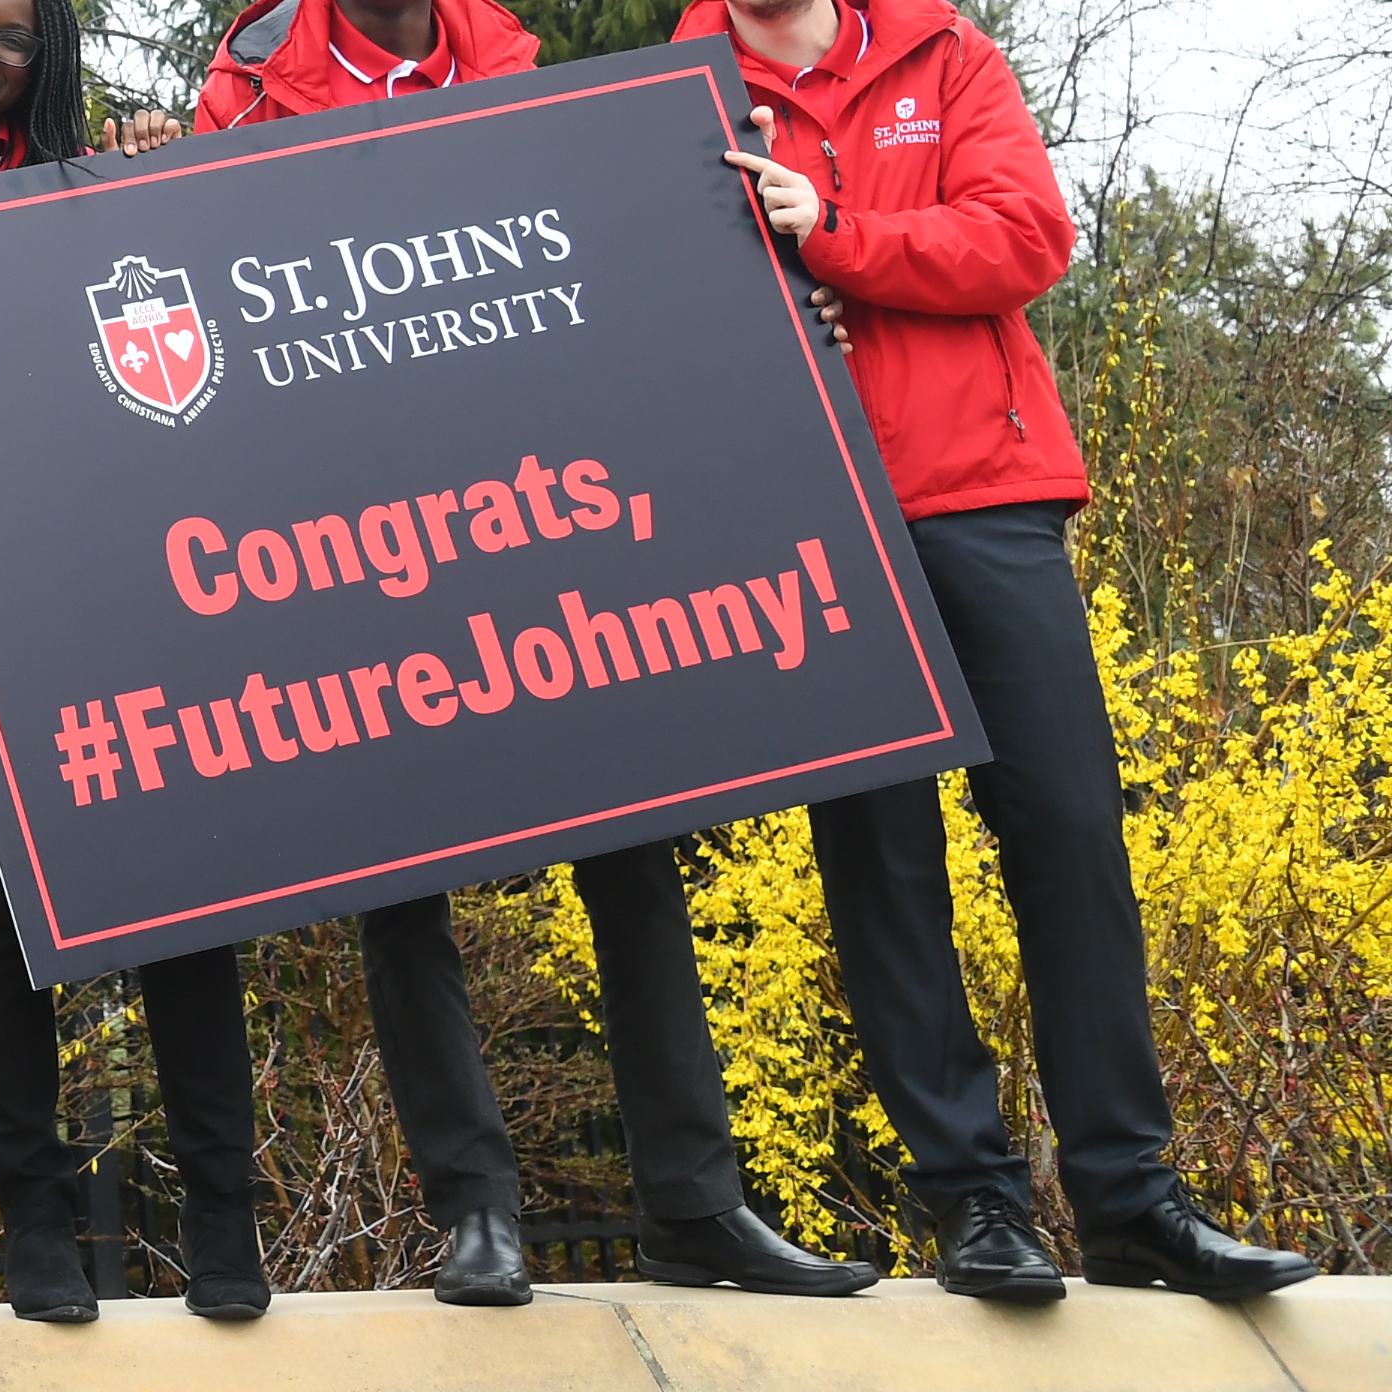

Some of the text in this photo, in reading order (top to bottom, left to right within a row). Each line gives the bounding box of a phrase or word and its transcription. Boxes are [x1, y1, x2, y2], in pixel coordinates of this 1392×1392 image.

[873, 126, 893, 140] ST.
[875, 133, 940, 149] UNIVERSITY
[133, 303, 156, 315] ECCE
[230, 208, 572, 323] ST. JOHN'S
[132, 311, 164, 326] AGNUS
[252, 282, 586, 387] UNIVERSITY
[88, 319, 225, 428] EDUCATIO CHRISTIANA ANIMAE PERFECTIO
[165, 454, 653, 616] Congrats,
[54, 538, 851, 807] #FutureJohnny!
